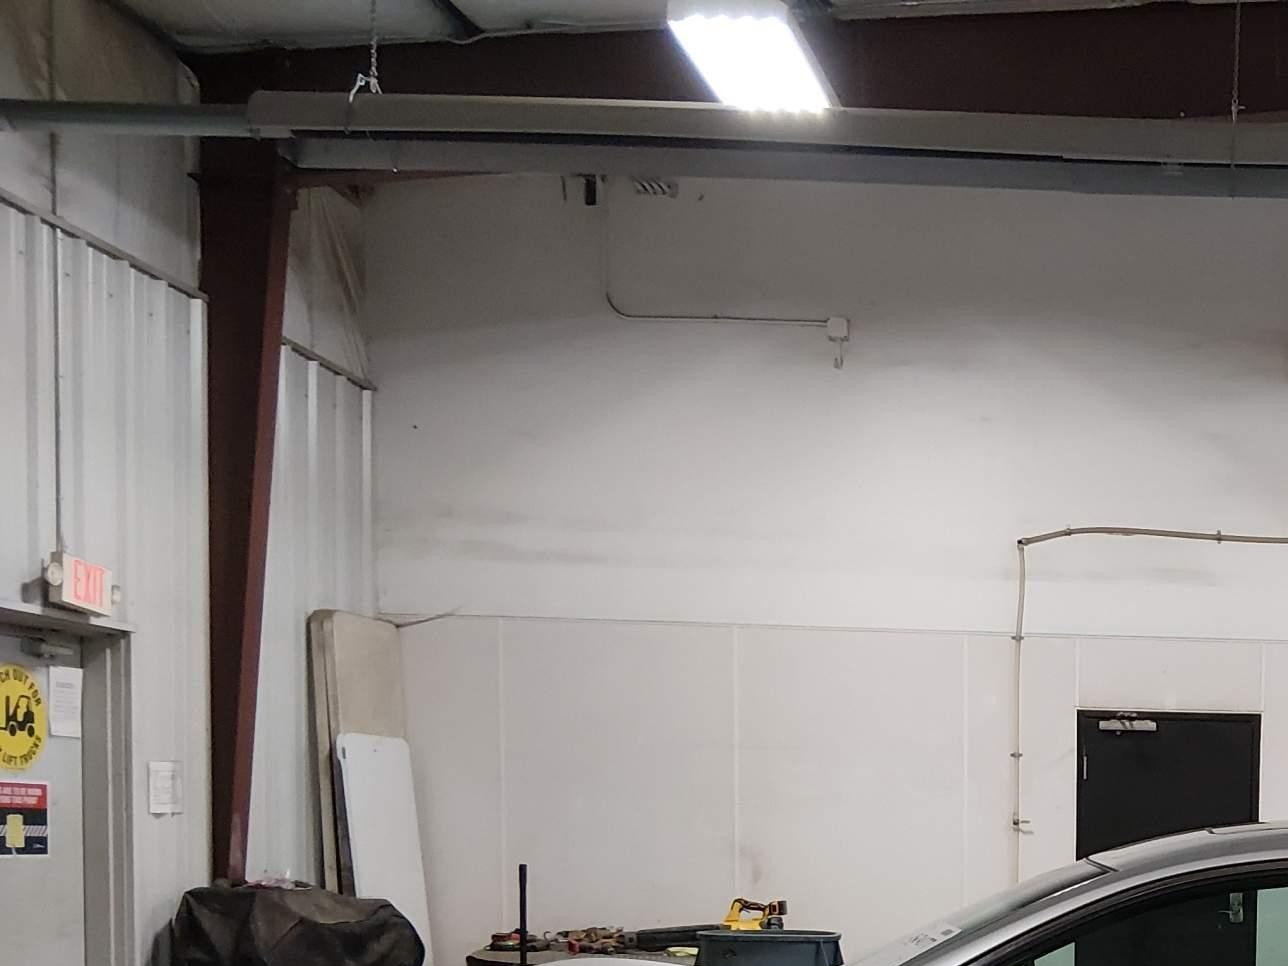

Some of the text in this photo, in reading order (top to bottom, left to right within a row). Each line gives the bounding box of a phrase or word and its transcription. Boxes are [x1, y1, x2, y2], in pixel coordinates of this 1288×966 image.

[73, 559, 105, 608] EXIT
[13, 669, 30, 685] OUT
[27, 681, 41, 707] FOR
[2, 735, 41, 766] LIFT TRUCKS
